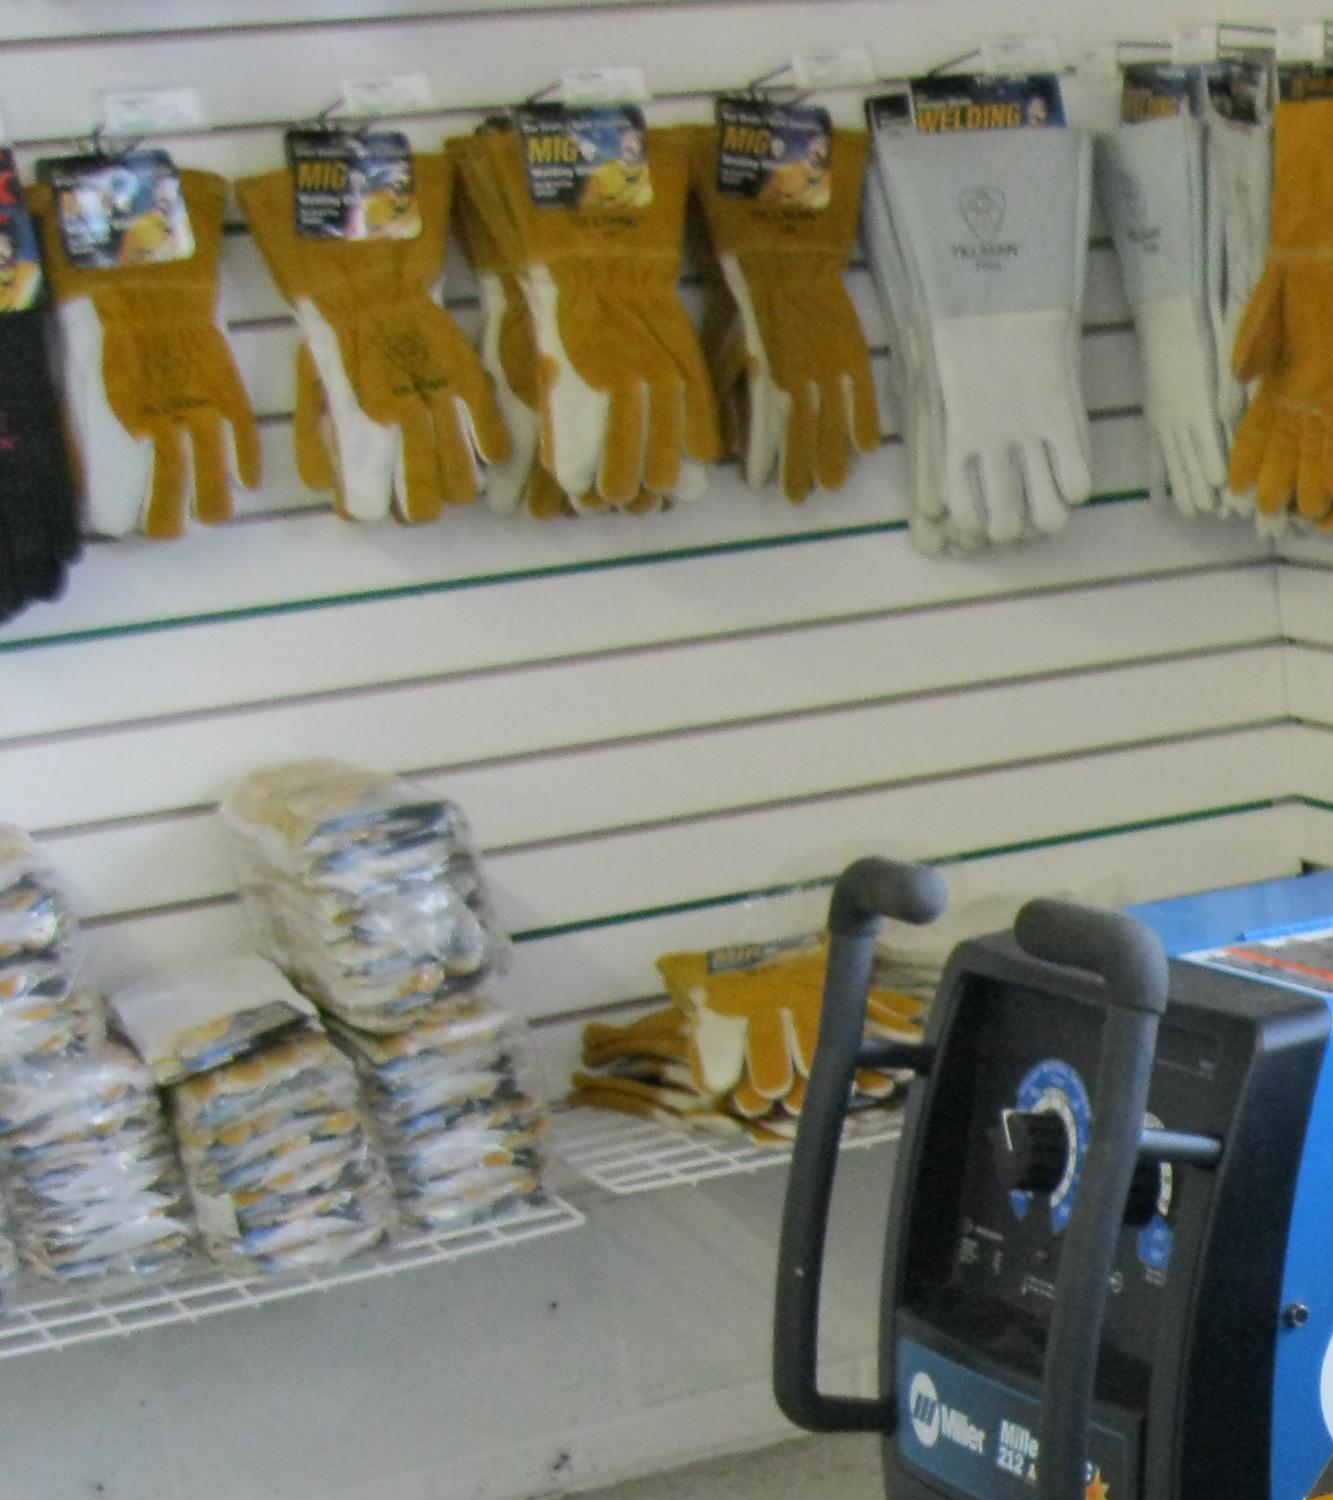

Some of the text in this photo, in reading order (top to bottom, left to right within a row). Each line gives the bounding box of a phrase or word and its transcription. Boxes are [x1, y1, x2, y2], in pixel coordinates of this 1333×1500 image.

[916, 101, 1023, 133] WELDING
[527, 135, 578, 164] MIG
[941, 1403, 986, 1454] Miller
